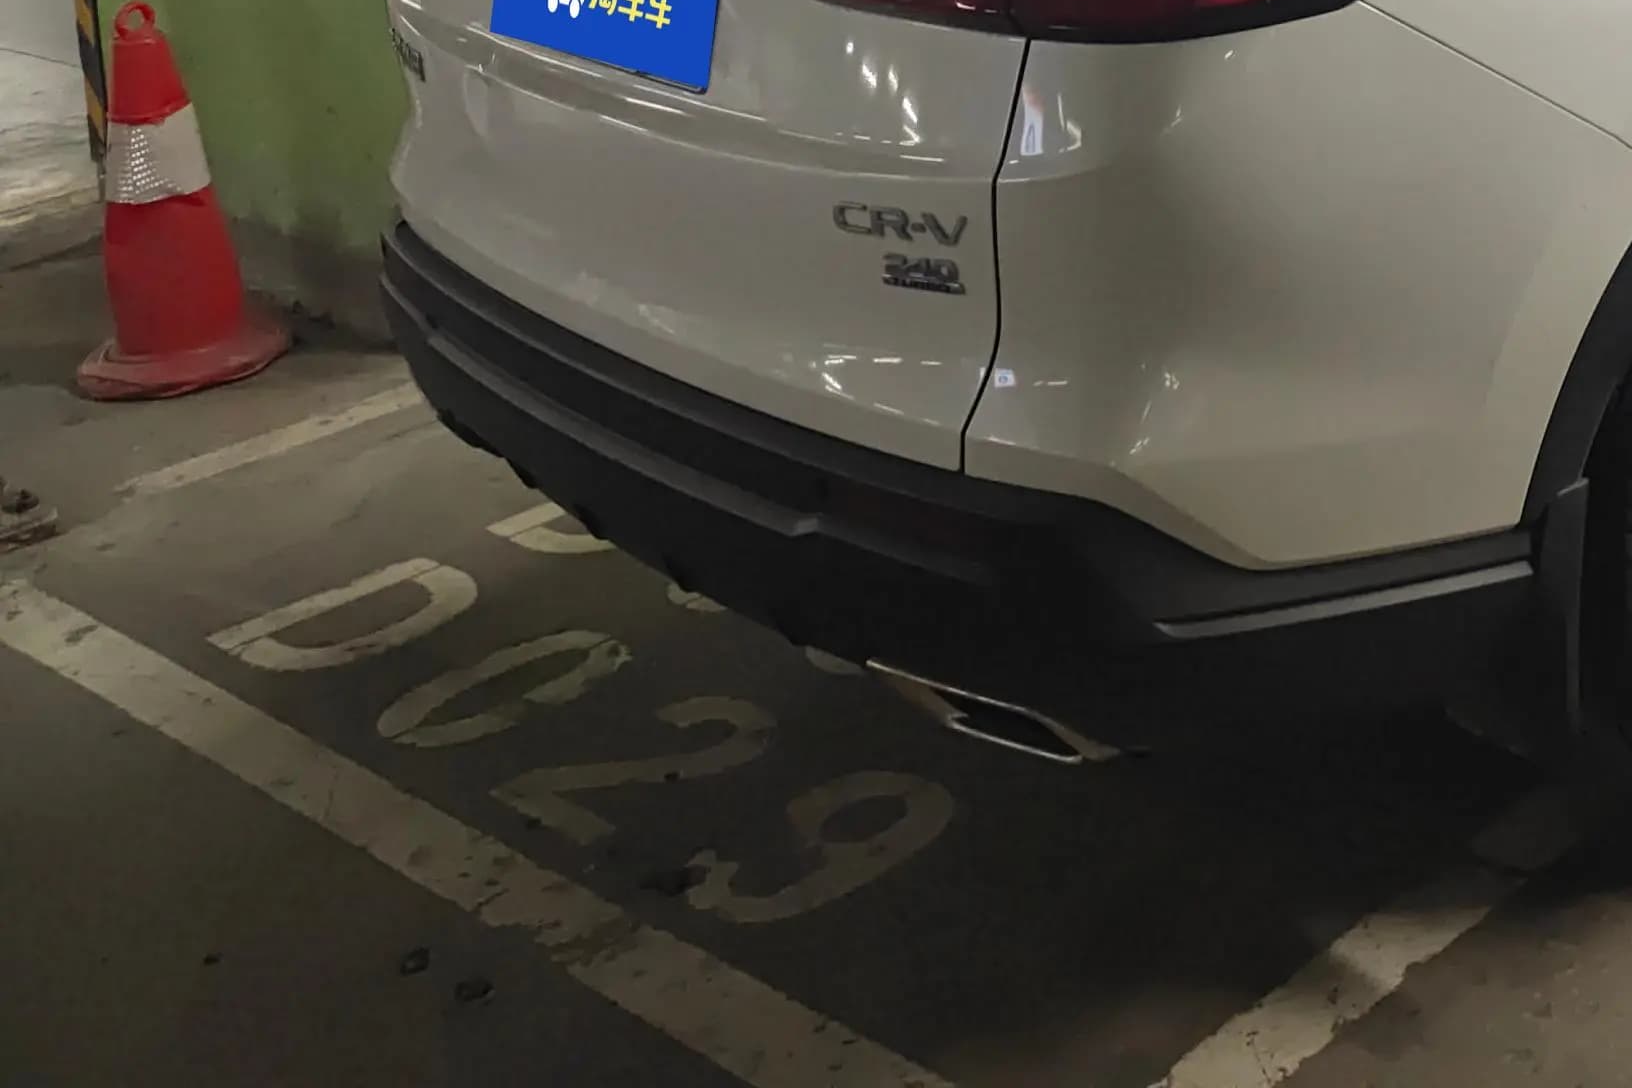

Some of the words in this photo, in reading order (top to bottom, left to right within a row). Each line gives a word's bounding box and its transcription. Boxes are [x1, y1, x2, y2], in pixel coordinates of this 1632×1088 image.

[833, 201, 969, 247] CR-V
[882, 253, 960, 283] 240
[206, 556, 958, 924] D029
